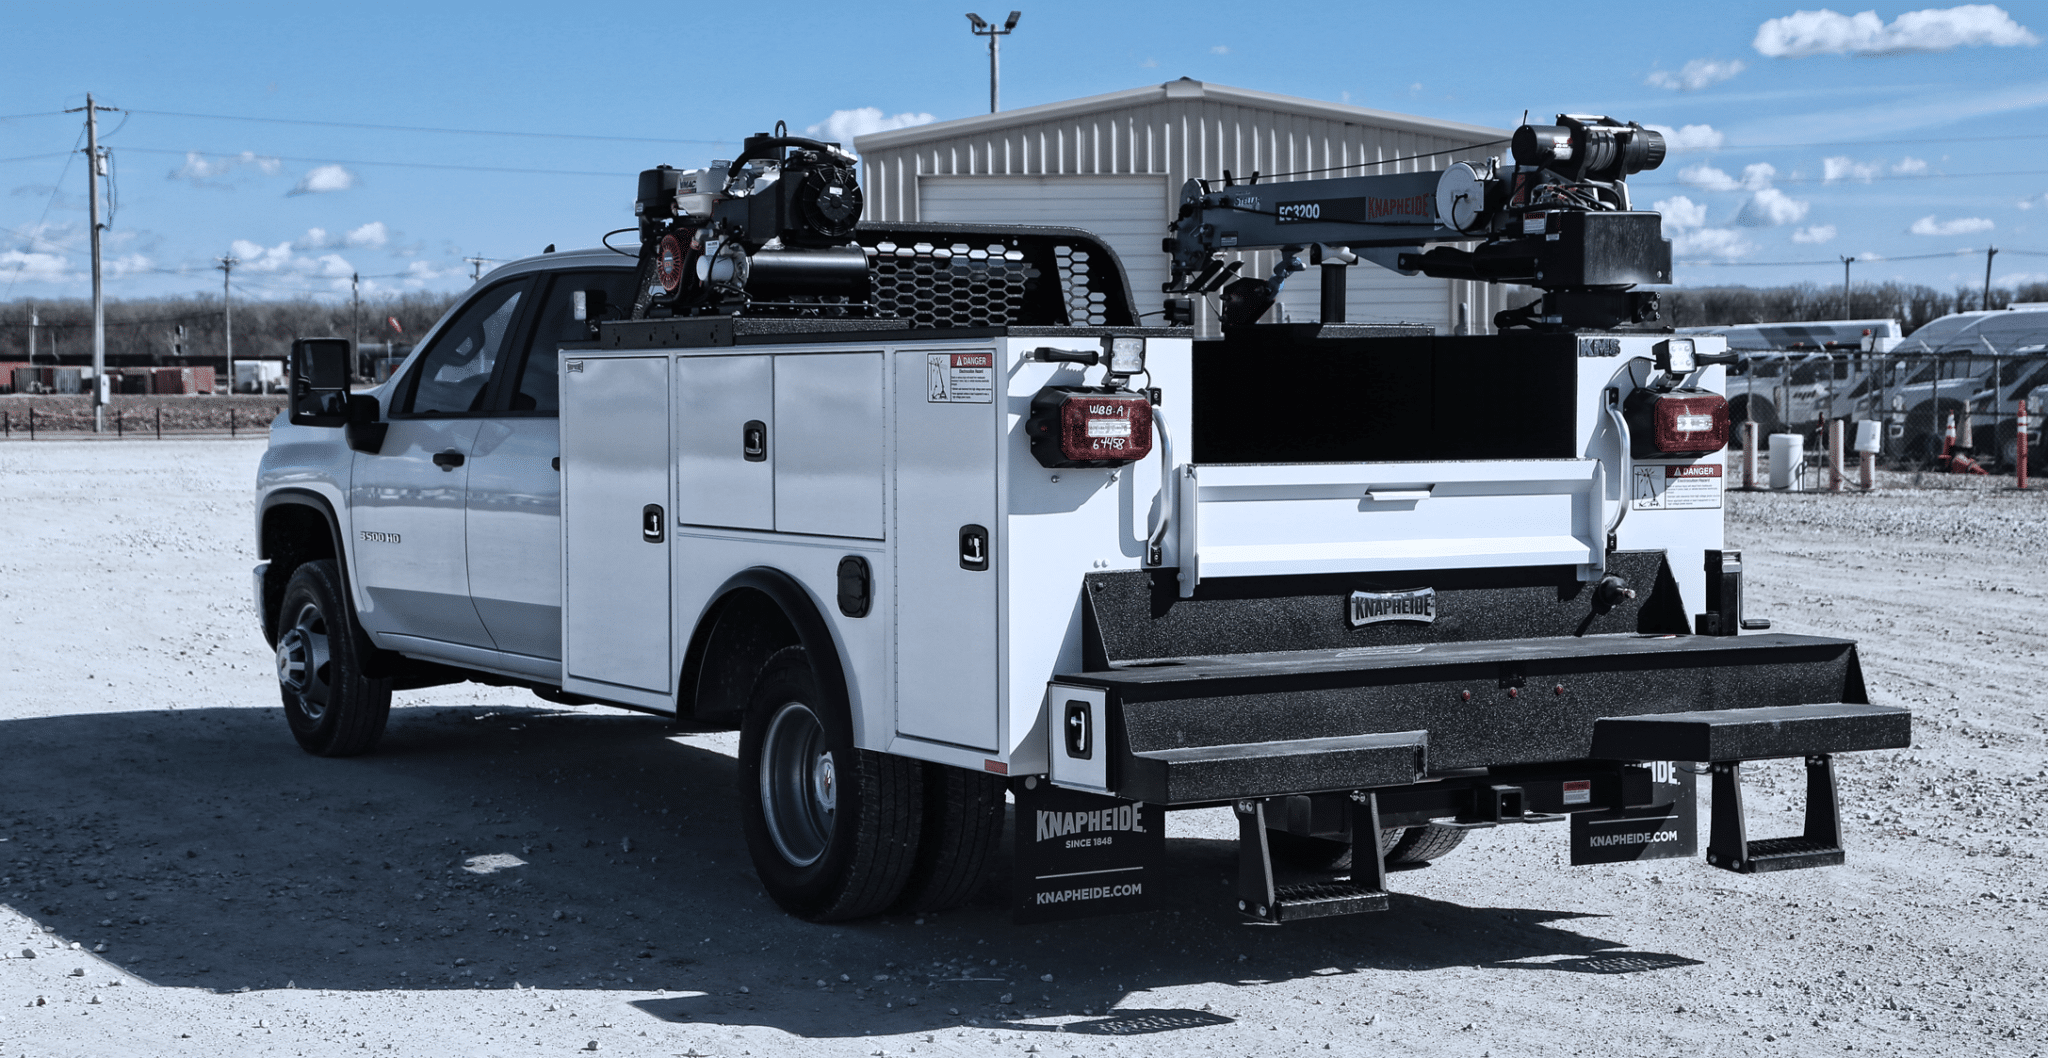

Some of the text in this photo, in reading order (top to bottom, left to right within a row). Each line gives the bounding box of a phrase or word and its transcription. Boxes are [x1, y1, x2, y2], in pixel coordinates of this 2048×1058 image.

[1279, 203, 1320, 221] EC3200
[1368, 193, 1430, 219] KNAPHEIDE
[1579, 338, 1621, 357] KMS
[962, 356, 987, 366] DANGER
[1092, 436, 1126, 451] 64458
[1683, 467, 1714, 476] DANGER
[360, 531, 401, 544] 3500 HD
[1356, 594, 1432, 620] KNAPHEIDE
[1065, 837, 1112, 849] SINCE 1848
[1590, 831, 1678, 847] KNAPHEIDE.COM
[1036, 883, 1142, 904] KNAPHEIDE.COM
